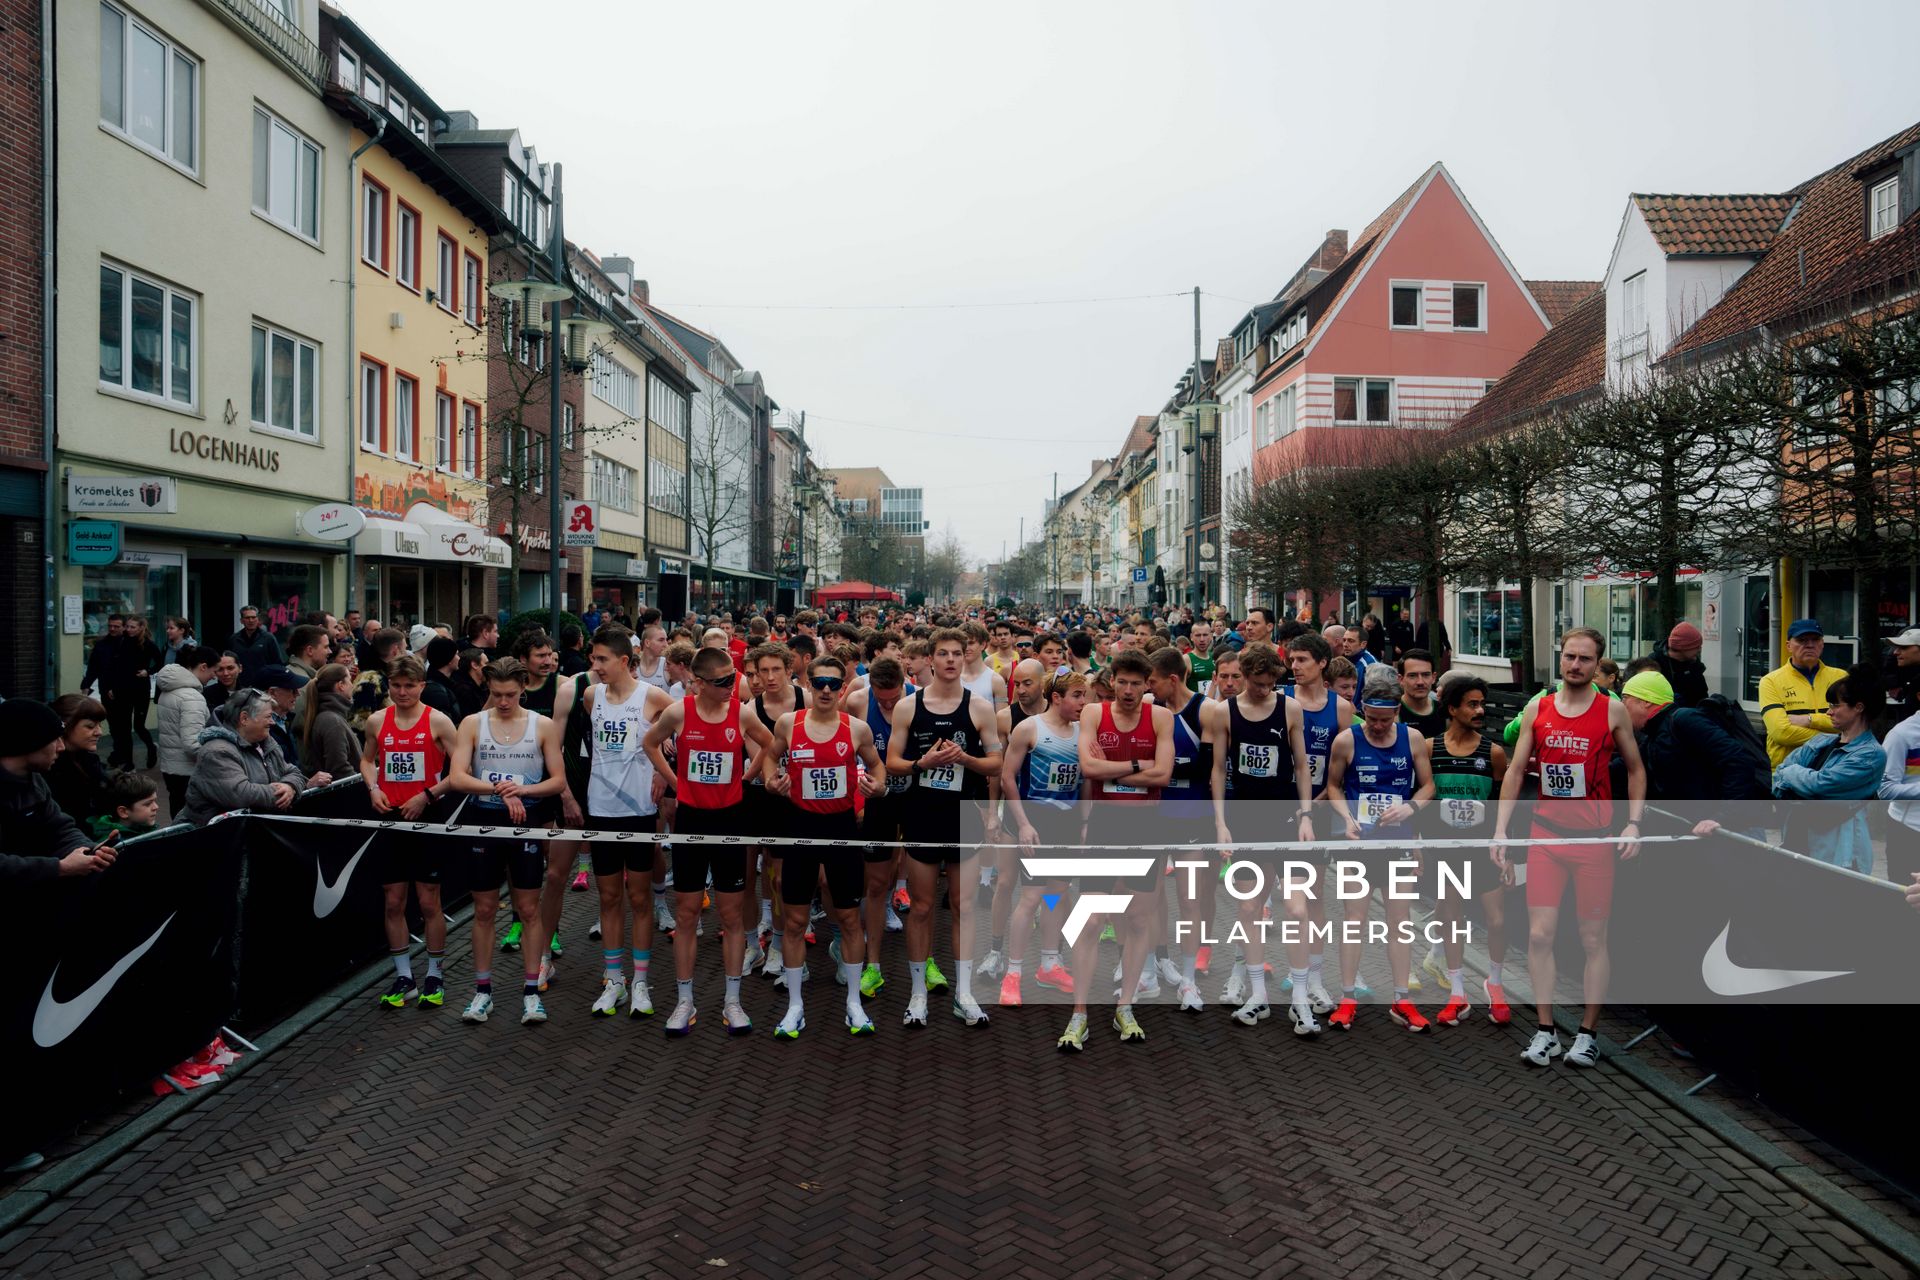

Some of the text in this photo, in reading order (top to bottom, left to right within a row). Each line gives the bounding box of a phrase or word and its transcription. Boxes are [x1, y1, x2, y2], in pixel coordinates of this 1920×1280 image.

[170, 428, 279, 472] LOGENHAUS
[75, 485, 134, 497] Krömelkes
[321, 509, 339, 522] 24/7
[1136, 570, 1144, 581] P
[267, 594, 299, 633] 24/7
[1878, 602, 1908, 618] LTAN
[604, 720, 627, 731] GLS
[604, 731, 628, 743] 757
[1545, 735, 1590, 751] GANTE
[1246, 745, 1270, 756] GLS
[391, 753, 414, 763] GLS
[697, 752, 723, 763] GLS
[1246, 755, 1270, 769] 802
[392, 762, 416, 774] 864
[698, 762, 722, 776] 151
[810, 768, 836, 779] GLS
[1057, 763, 1078, 774] GLS
[1546, 764, 1572, 776] GLS
[929, 768, 955, 782] 779
[1056, 773, 1077, 785] 812
[811, 778, 838, 791] 150
[1548, 775, 1575, 789] 309
[1367, 794, 1393, 805] GLS
[1448, 800, 1474, 811] GLS
[1368, 804, 1391, 817] 65
[1450, 810, 1476, 822] 142
